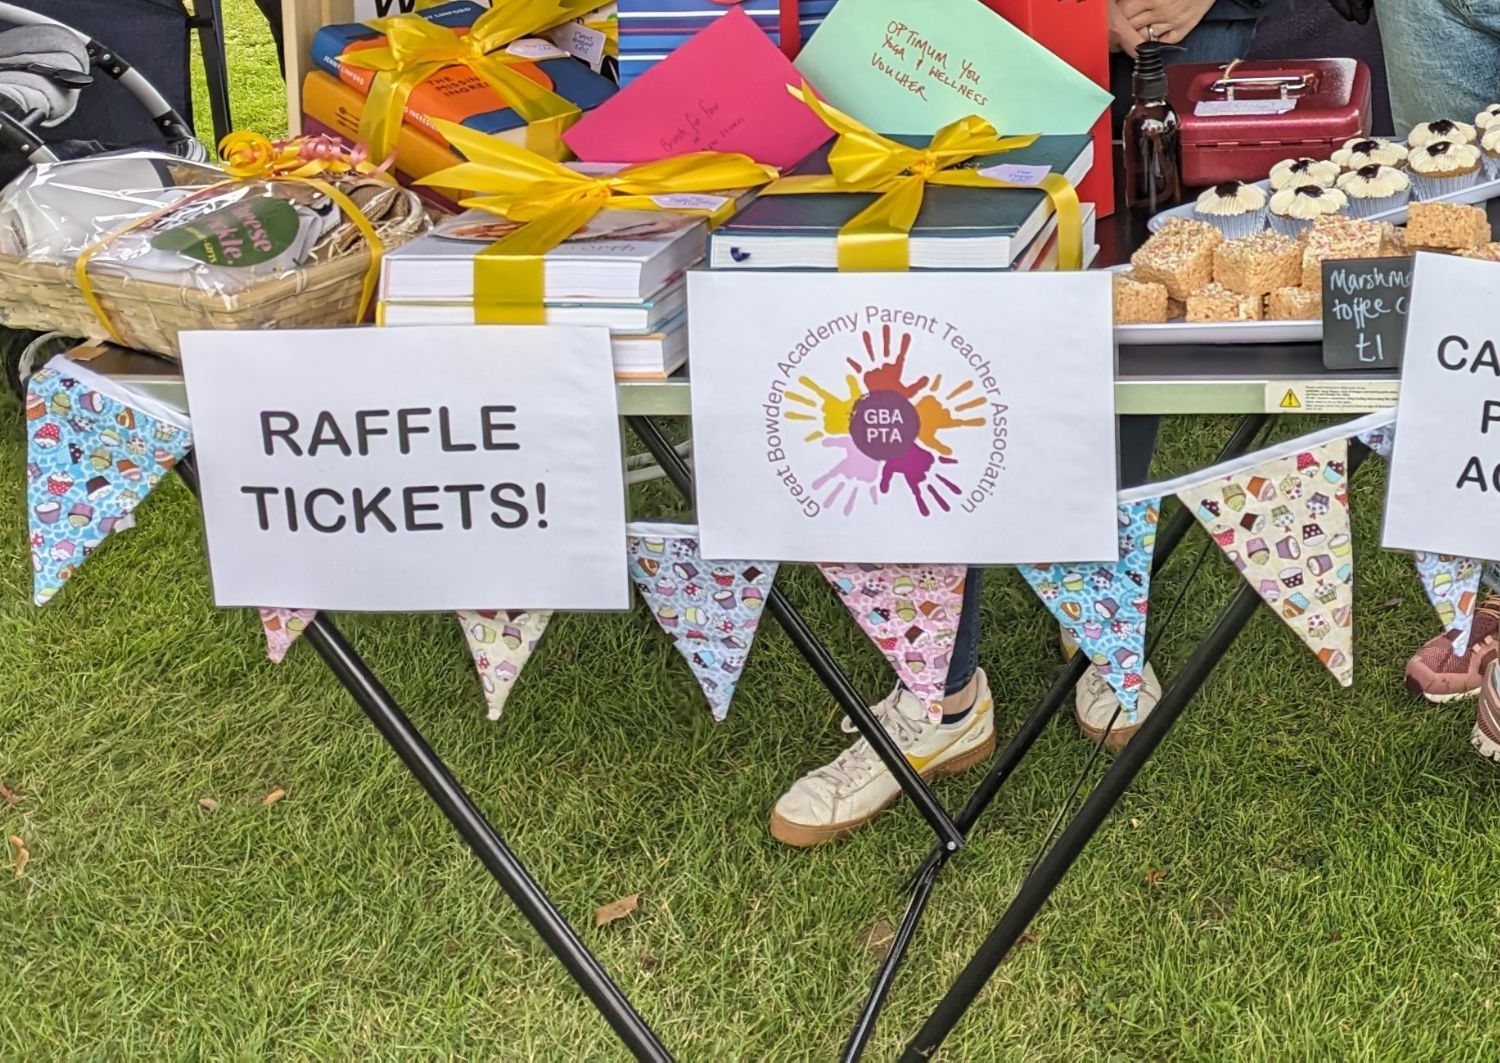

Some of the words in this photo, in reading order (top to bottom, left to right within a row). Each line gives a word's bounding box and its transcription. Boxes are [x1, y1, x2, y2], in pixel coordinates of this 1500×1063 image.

[871, 52, 928, 102] VOUCHER
[881, 33, 905, 61] YOGA
[928, 65, 989, 106] WELLNESS
[887, 20, 948, 70] OPTIMUM
[958, 59, 981, 85] YOU
[865, 304, 938, 335] Parent
[1332, 297, 1391, 330] toffee
[777, 311, 860, 379] Academy
[942, 321, 1002, 396] Teacher
[1355, 332, 1385, 363] £1
[259, 403, 522, 458] RAFFLE
[762, 379, 786, 464] Bowden
[863, 408, 904, 425] GBA
[865, 427, 904, 444] PTA
[961, 401, 1009, 515] Association
[240, 481, 549, 535] TICKETS!
[775, 465, 822, 519] Great
